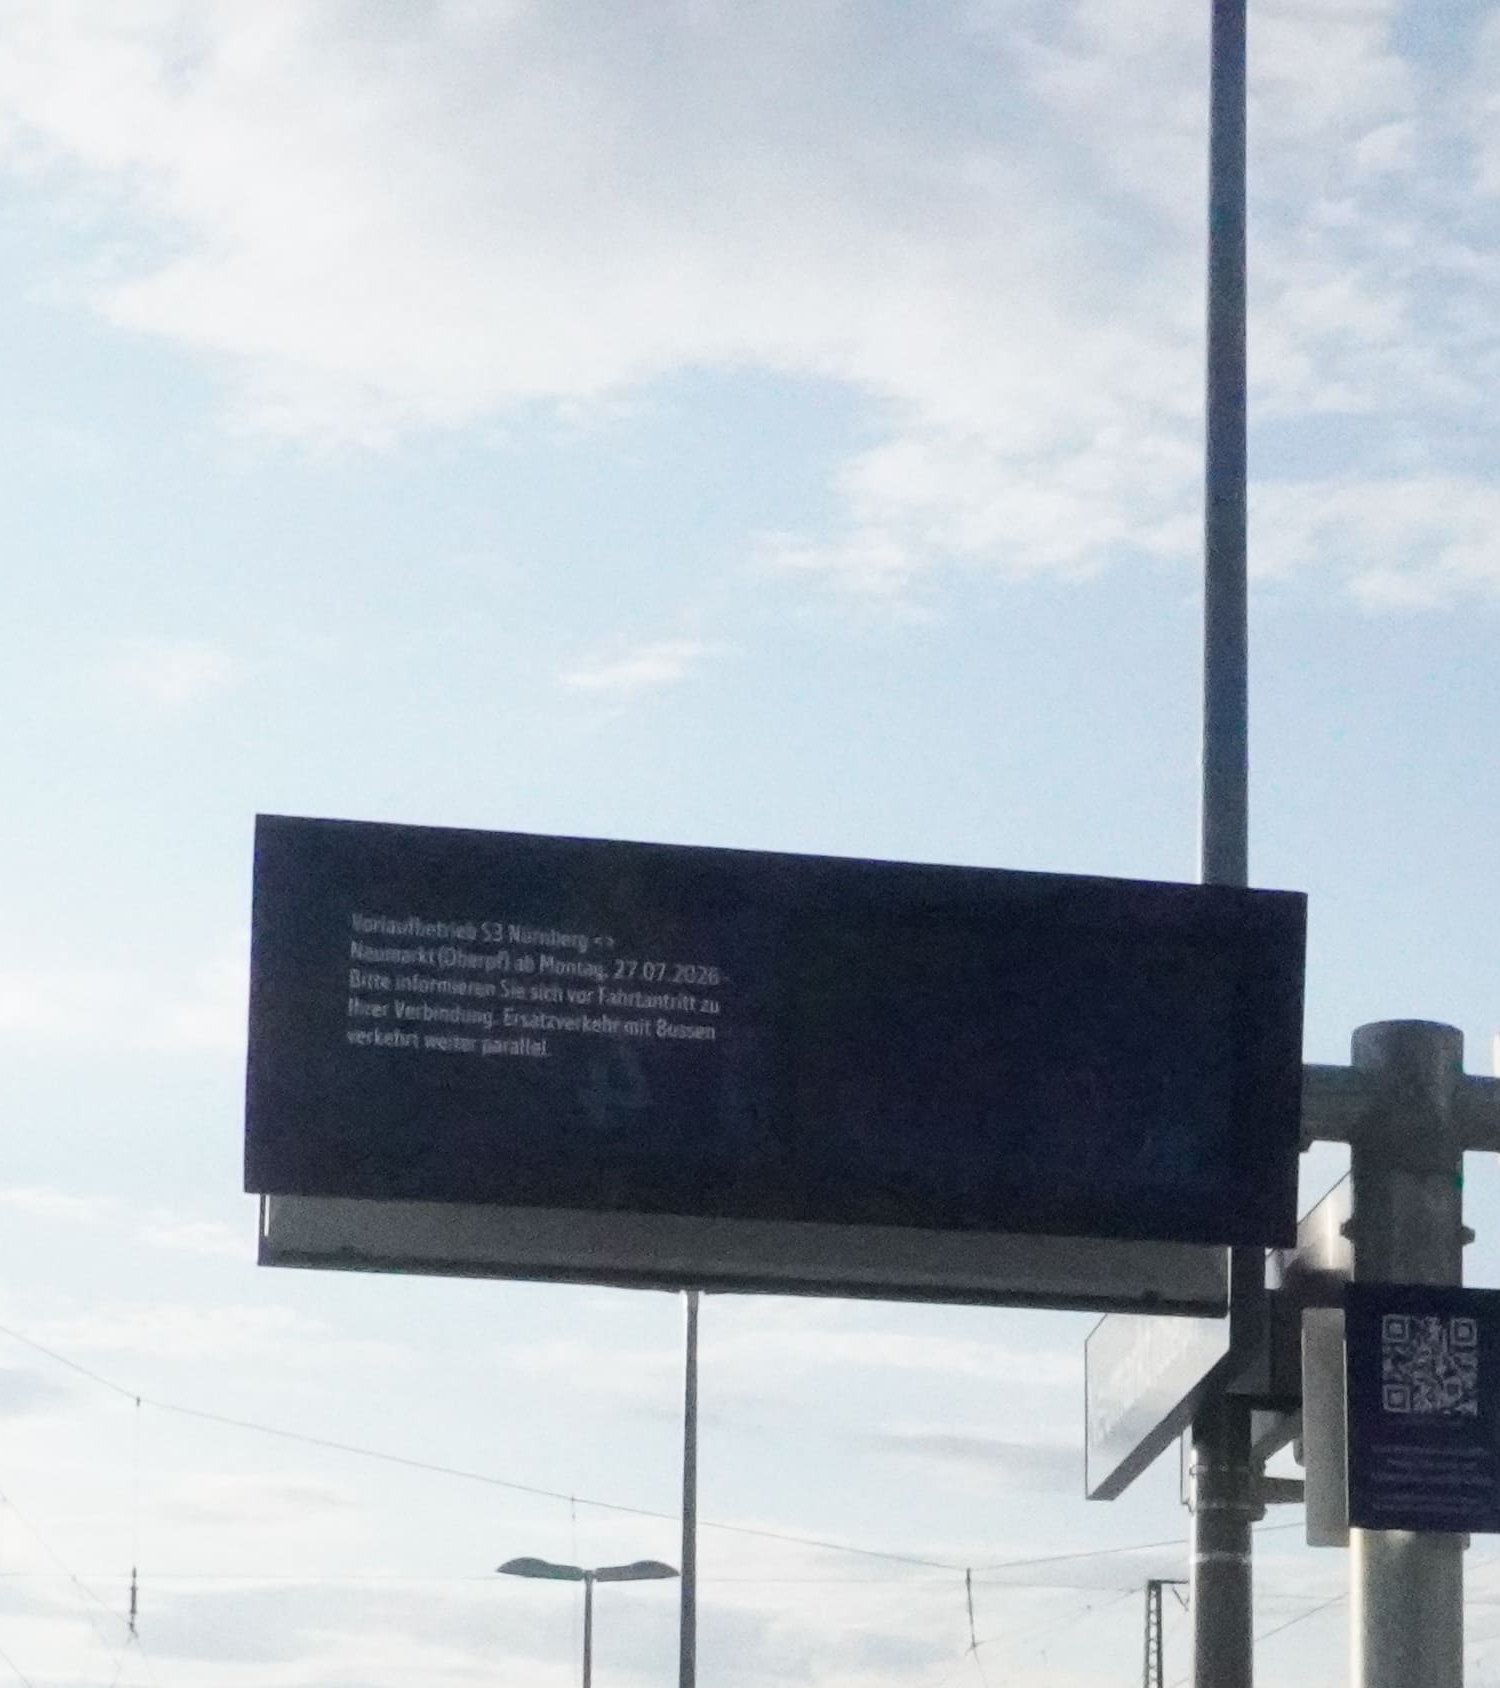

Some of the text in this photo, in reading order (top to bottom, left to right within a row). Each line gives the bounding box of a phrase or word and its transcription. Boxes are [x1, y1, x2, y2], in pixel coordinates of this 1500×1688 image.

[480, 922, 503, 942] S3
[349, 968, 391, 990] Bitte
[395, 973, 496, 997] informieren
[499, 979, 525, 999] Sie
[529, 985, 563, 1003] sich
[567, 989, 594, 1005] vor
[623, 1018, 651, 1036] mit
[656, 1018, 716, 1040] Bussen
